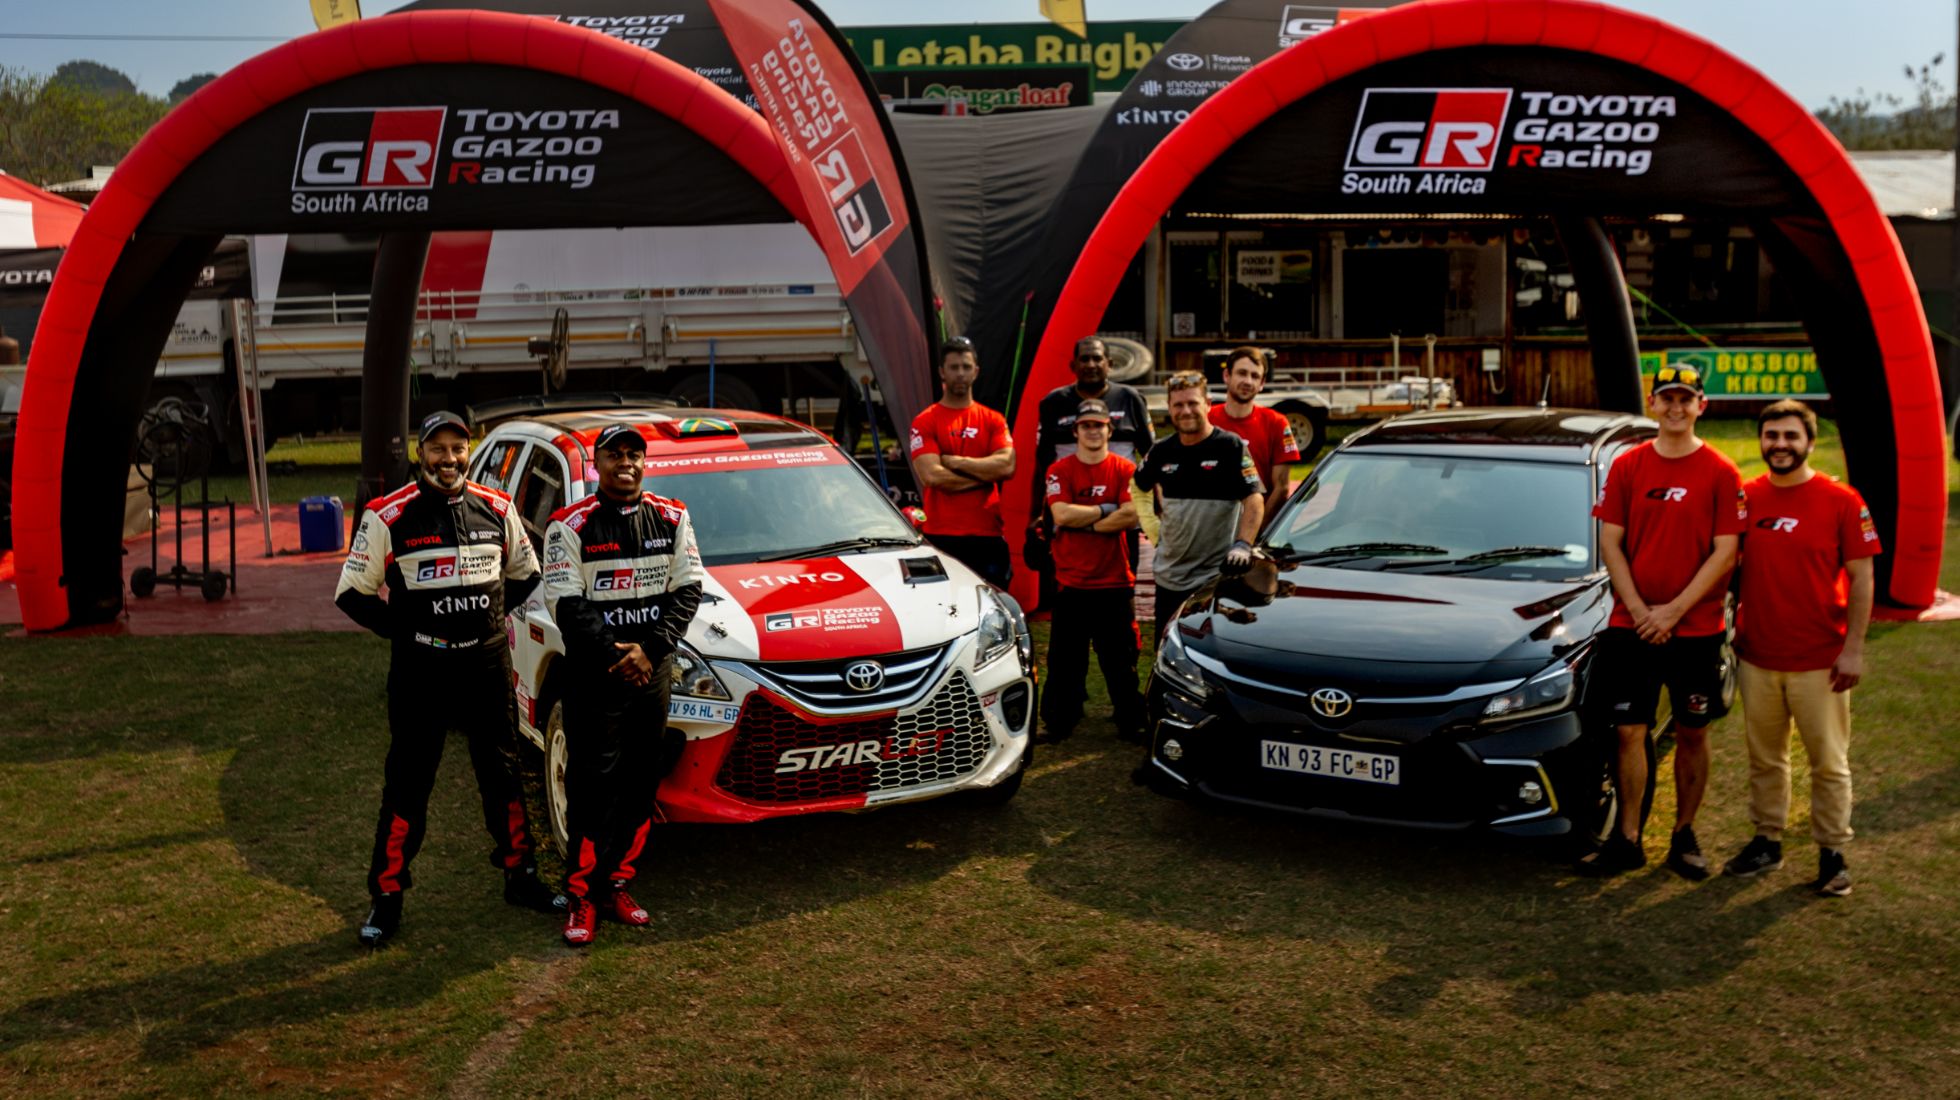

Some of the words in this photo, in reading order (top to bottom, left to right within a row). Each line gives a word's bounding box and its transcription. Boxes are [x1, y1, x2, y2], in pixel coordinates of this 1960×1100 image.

[567, 14, 685, 27] TOYOTA
[592, 26, 669, 37] ZOO
[1212, 54, 1251, 63] Toyota
[695, 66, 732, 75] Toyota
[1167, 88, 1208, 96] GROUP
[1521, 92, 1676, 116] TOYOTA
[456, 109, 619, 132] TOYOTA
[1513, 119, 1660, 142] GAZOO
[452, 136, 602, 158] GAZOO
[1356, 122, 1495, 165] GR
[301, 140, 432, 185] GR
[1507, 144, 1652, 175] Racing
[449, 160, 595, 188] Racing
[1341, 173, 1411, 194] South
[1416, 173, 1487, 194] Africa
[291, 192, 356, 213] South
[363, 191, 429, 212] Africa
[645, 457, 712, 468] TOYOTA
[715, 453, 773, 463] GAZOO
[774, 450, 825, 460] Racing
[1646, 486, 1688, 502] GR
[1757, 516, 1799, 533] GR
[405, 535, 443, 548] TOYOTA
[585, 543, 621, 553] TOYOTA
[418, 563, 455, 582] GR
[459, 568, 492, 577] Racing
[461, 561, 492, 569] GAZOO
[636, 565, 669, 575] TOYOTA
[595, 577, 633, 590] GR
[634, 579, 665, 588] Racing
[635, 572, 667, 581] GAZOO
[822, 606, 883, 614] TOYOTA
[823, 612, 880, 620] GAZOO
[767, 615, 820, 631] GR
[824, 617, 880, 625] Racing
[683, 703, 697, 716] 96
[699, 704, 714, 718] HL
[724, 707, 740, 721] GP
[775, 729, 955, 774] STARLET
[1266, 744, 1290, 767] KN
[1299, 748, 1322, 771] 93
[1330, 752, 1354, 775] FC
[1371, 757, 1395, 781] GP
